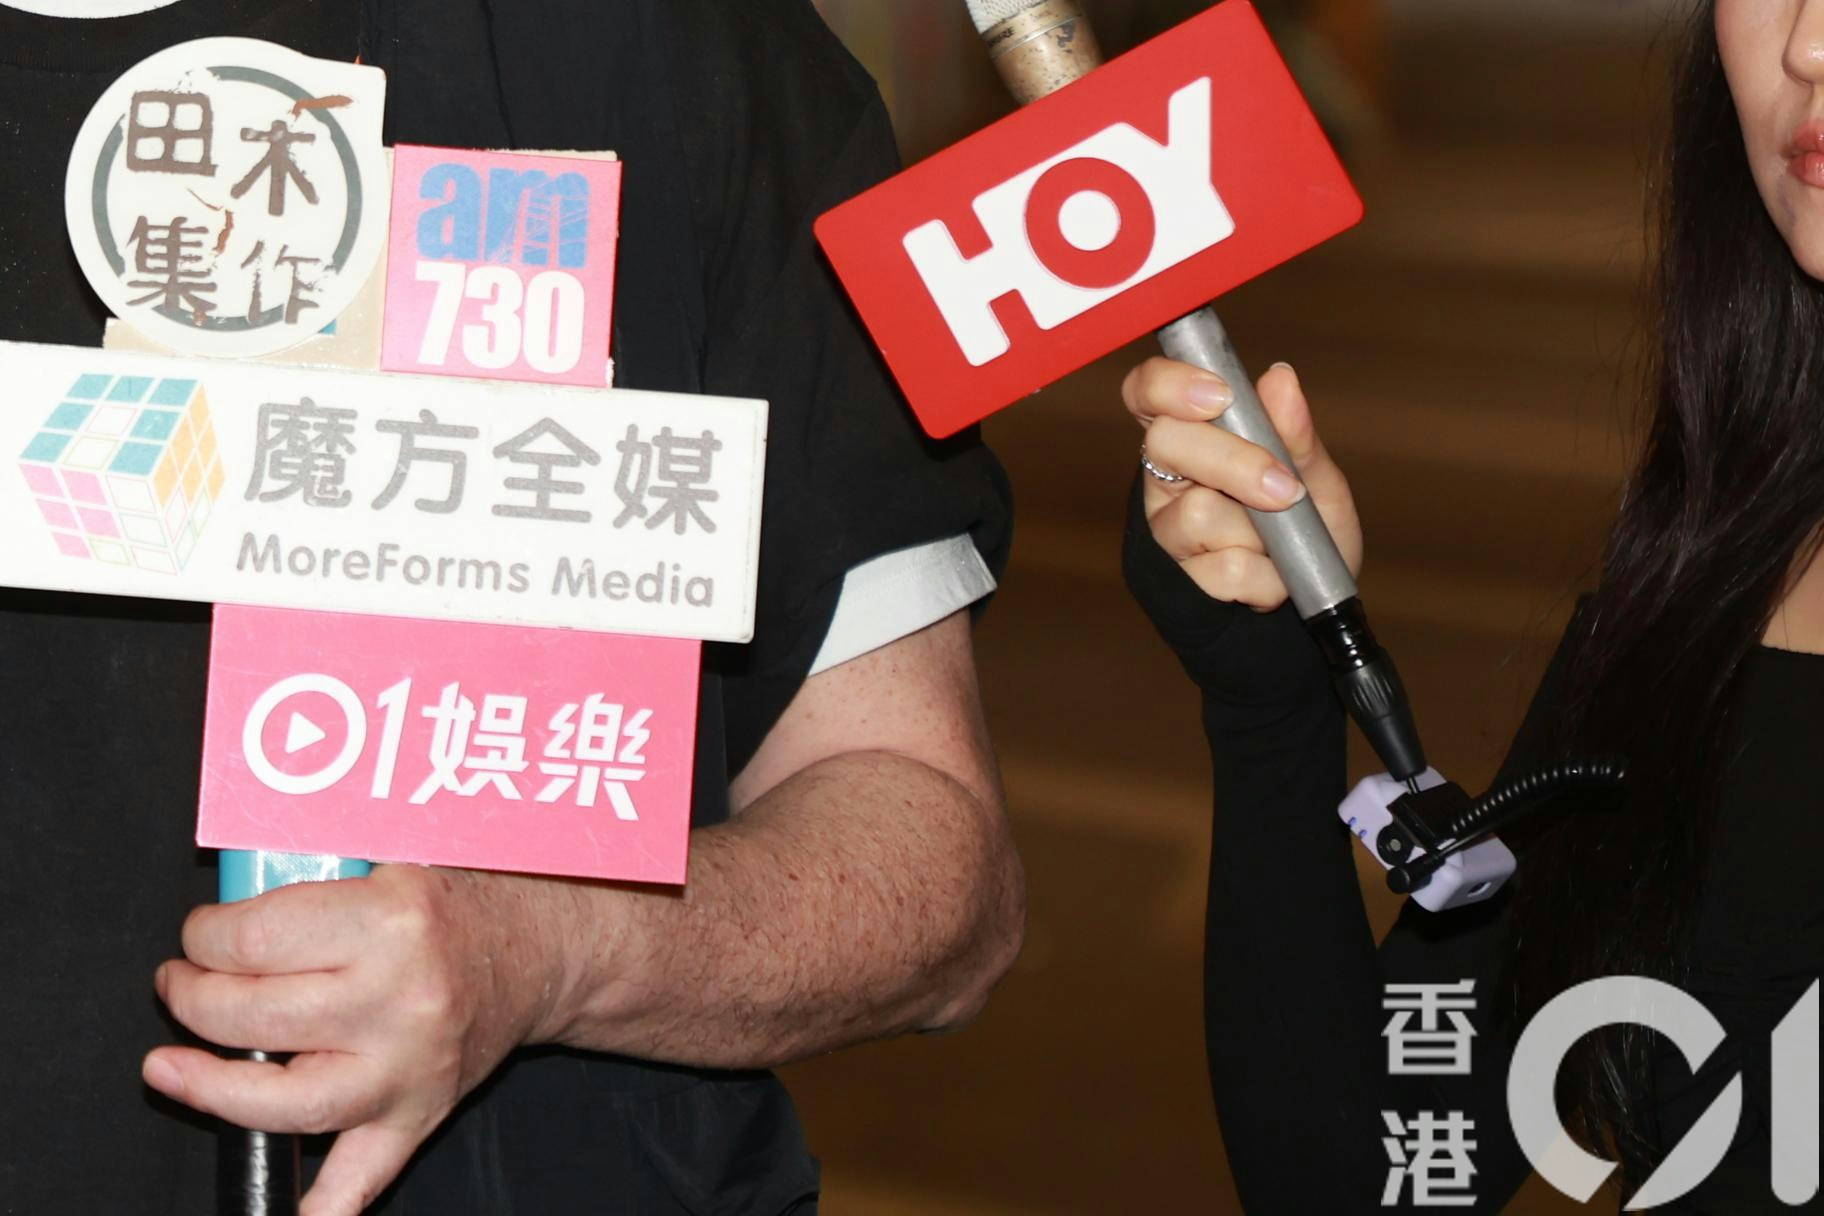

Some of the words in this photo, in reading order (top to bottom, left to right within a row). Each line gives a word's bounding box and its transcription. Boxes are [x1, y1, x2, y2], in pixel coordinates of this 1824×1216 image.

[126, 89, 320, 217] 田木
[416, 161, 590, 269] am
[902, 75, 1237, 367] HOY
[416, 261, 585, 374] 730
[243, 396, 724, 536] 魔方全媒
[236, 532, 531, 595] MoreForms
[552, 557, 716, 609] Media
